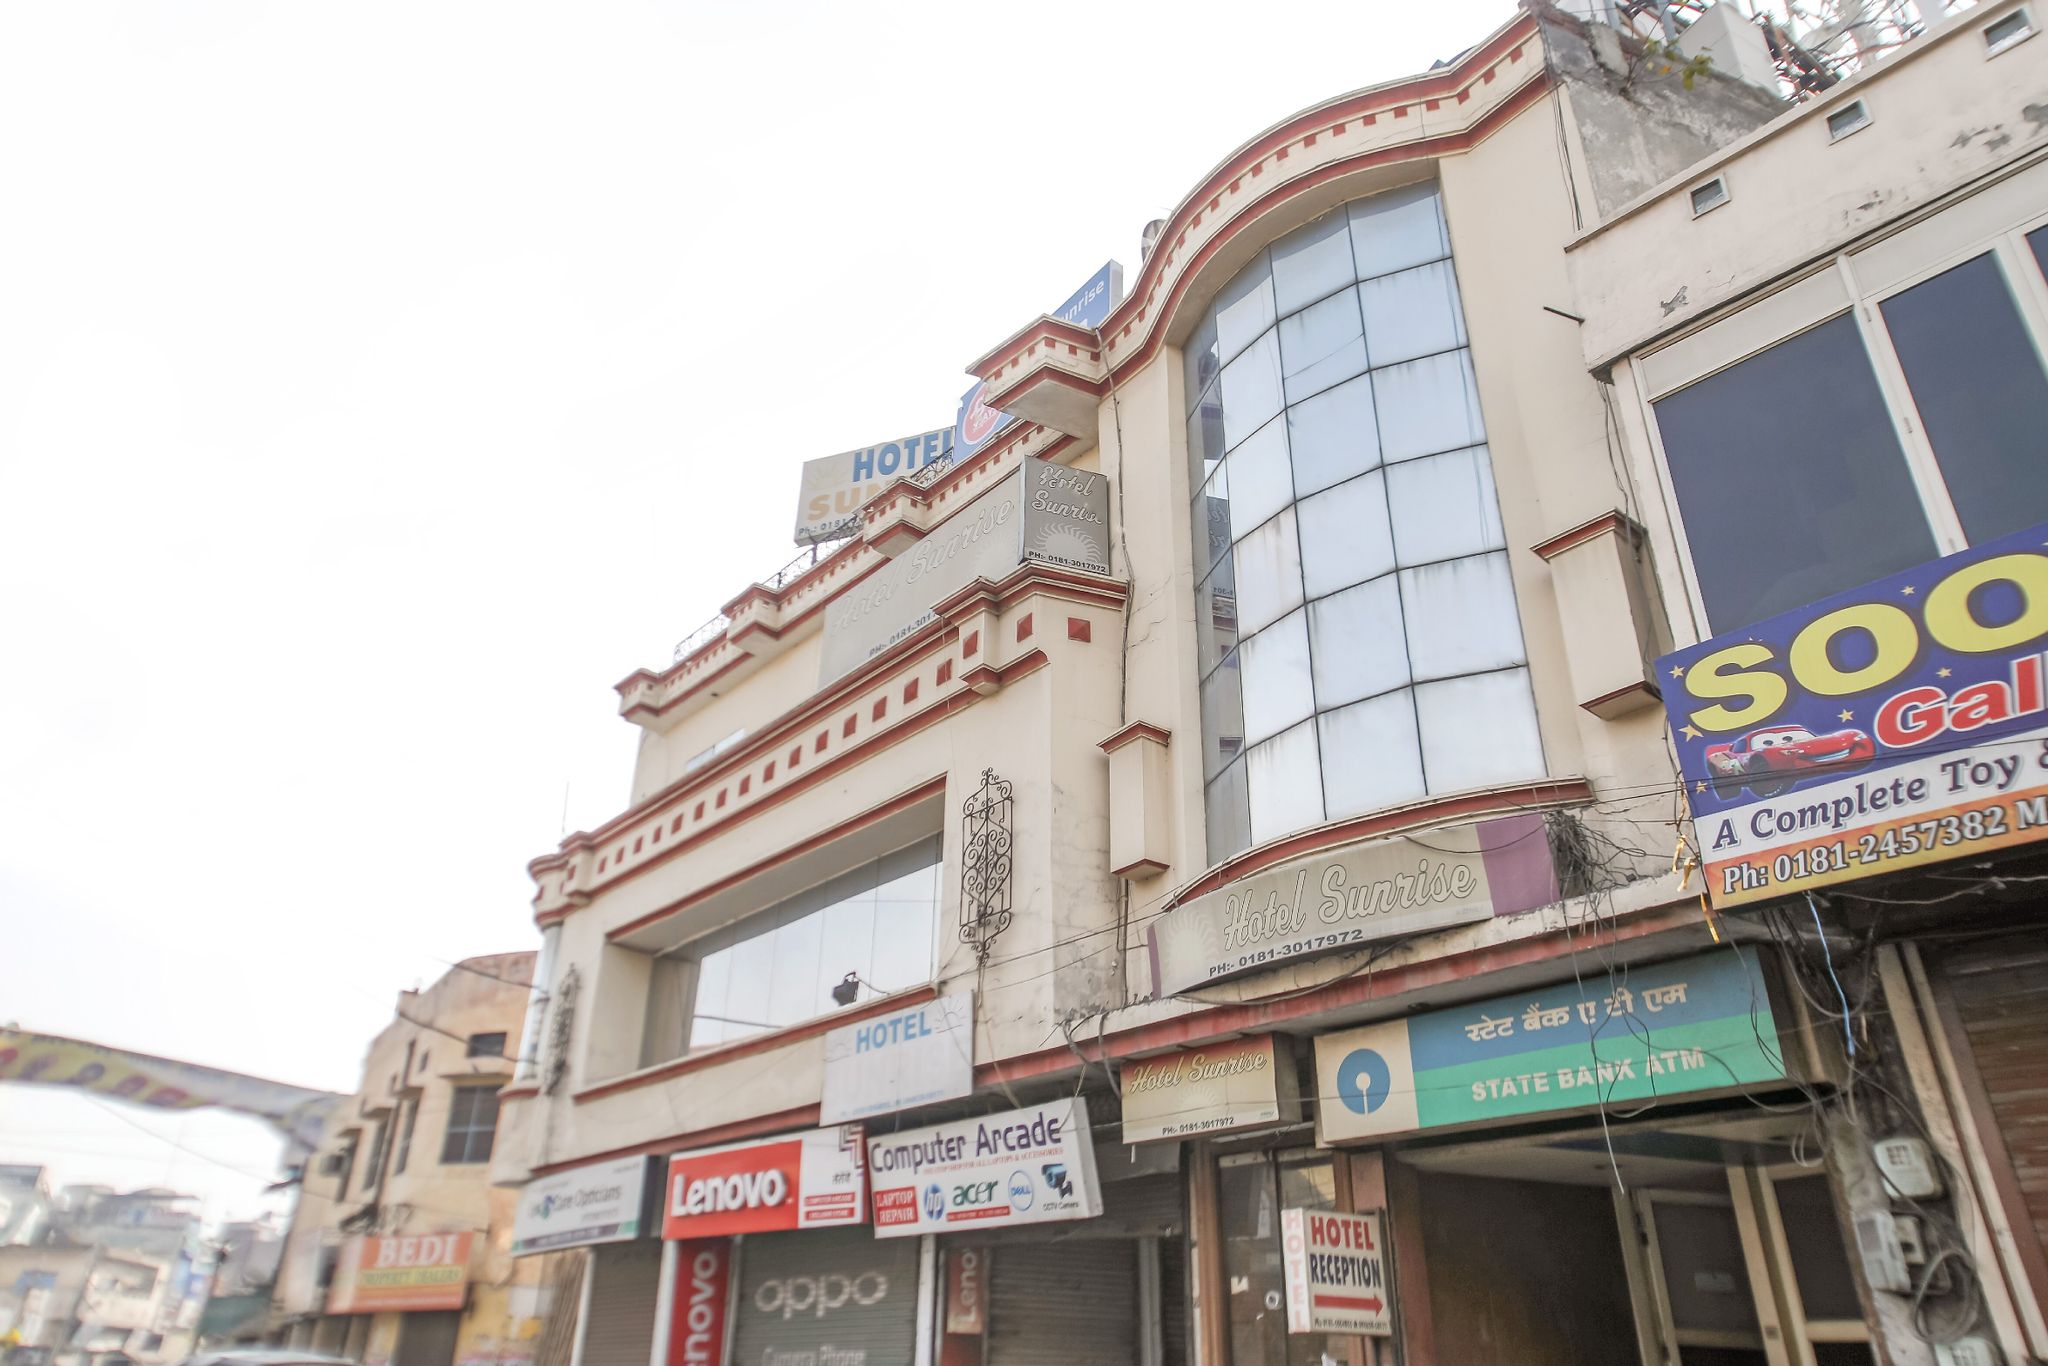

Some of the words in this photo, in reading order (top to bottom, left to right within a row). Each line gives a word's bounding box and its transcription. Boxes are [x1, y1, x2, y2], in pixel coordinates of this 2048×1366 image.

[1061, 280, 1104, 320] unrise
[1039, 465, 1095, 496] Hotel
[906, 499, 1014, 584] Sunrise
[1048, 555, 1106, 572] 0181-3017972
[889, 612, 936, 643] 0181-301
[1874, 651, 2048, 748] Gal
[1712, 817, 1740, 851] A
[1750, 775, 1926, 838] Complete
[1941, 754, 2019, 791] Toy
[1723, 861, 1768, 895] Ph:
[1773, 804, 2006, 881] 0181-2457382
[1223, 869, 1307, 951] Hotel
[1317, 859, 1476, 925] Sunrise
[1238, 928, 1364, 968] 0181-3017972
[855, 1011, 932, 1054] HOTEL
[1129, 1055, 1184, 1095] Hotel
[1188, 1051, 1267, 1083] Sunrise
[1471, 1072, 1550, 1101] STATE
[1558, 1058, 1636, 1090] BANK
[1645, 1046, 1706, 1077] ATM
[871, 1131, 967, 1175] Computer
[976, 1112, 1062, 1157] Arcade
[1179, 1116, 1235, 1133] 0181-3017972
[671, 1168, 787, 1217] Lenovo
[875, 1191, 914, 1206] LAPTOP
[926, 1186, 942, 1220] hp
[953, 1180, 999, 1206] acer
[879, 1208, 914, 1224] REPAIR
[1310, 1216, 1375, 1250] HOTEL
[374, 1233, 460, 1268] BEDI
[1309, 1253, 1382, 1288] RECEPTION
[755, 1271, 888, 1320] oppo
[955, 1247, 977, 1322] Leno
[684, 1251, 718, 1366] novo
